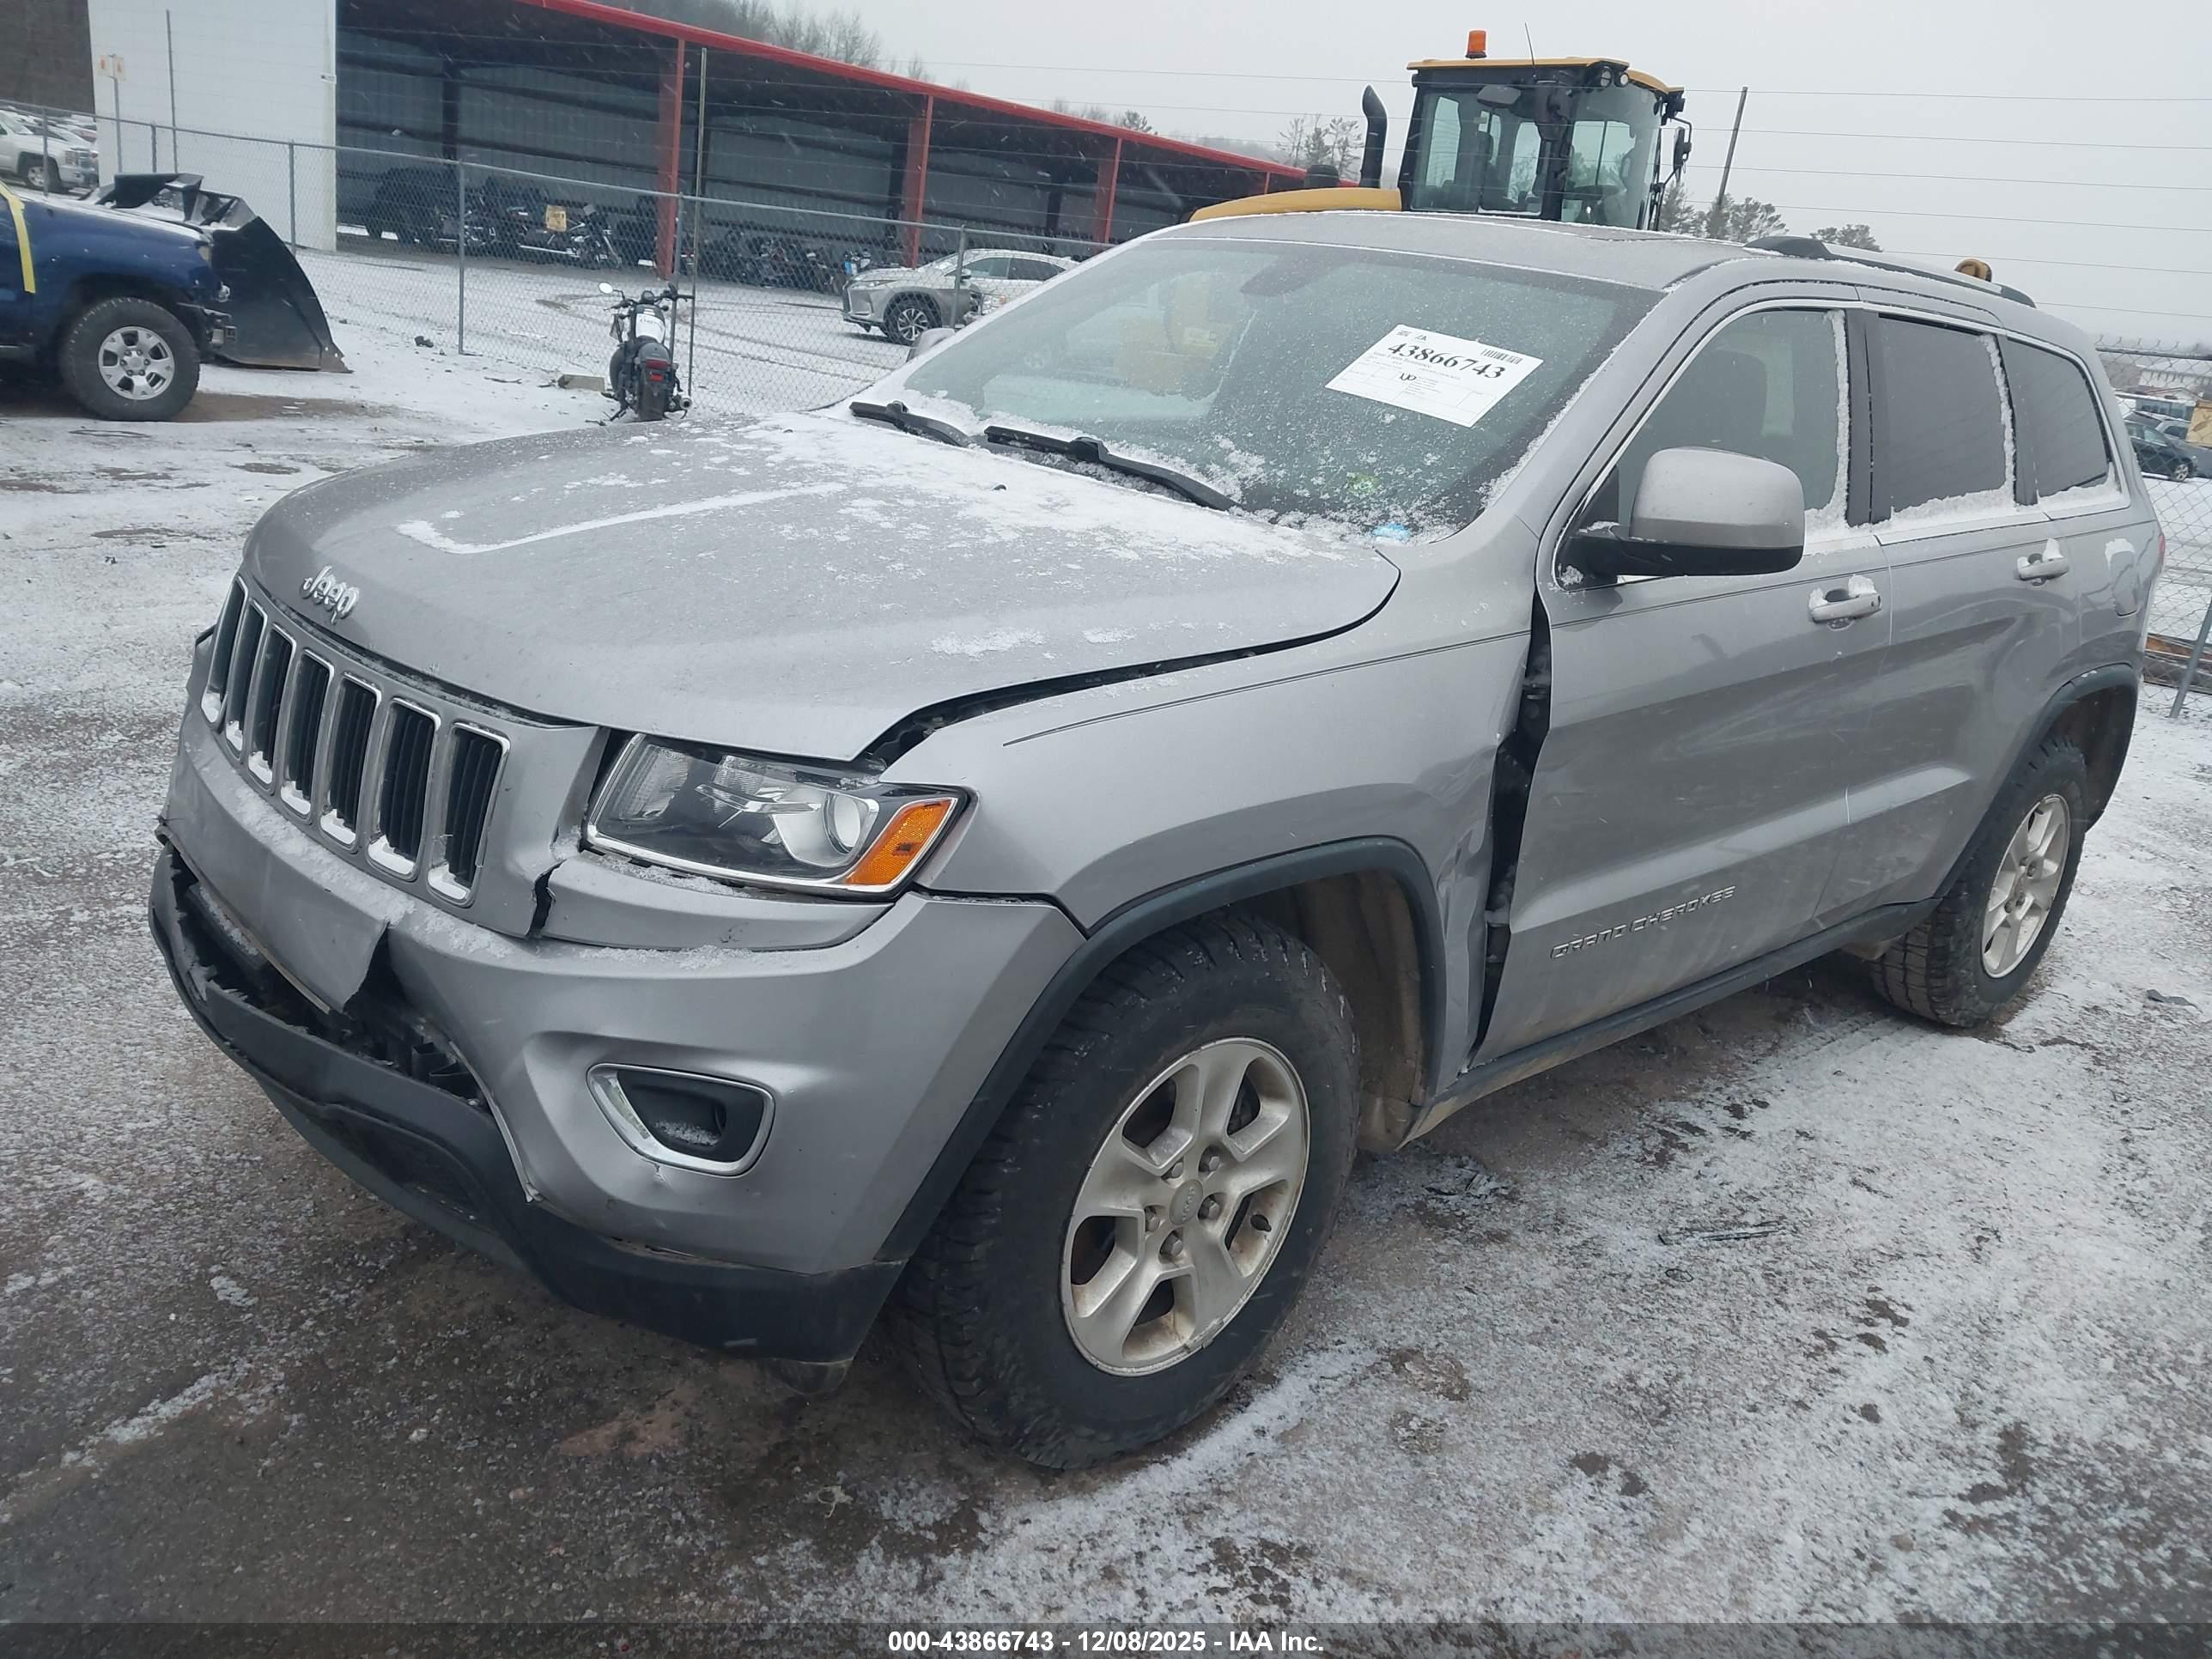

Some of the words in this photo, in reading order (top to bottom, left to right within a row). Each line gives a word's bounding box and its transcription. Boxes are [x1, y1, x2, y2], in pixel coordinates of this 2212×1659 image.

[1388, 343, 1506, 379] 43866743
[301, 565, 359, 624] Jeep
[1550, 924, 1627, 959] GRAND
[1630, 885, 1736, 933] CHEROKEE
